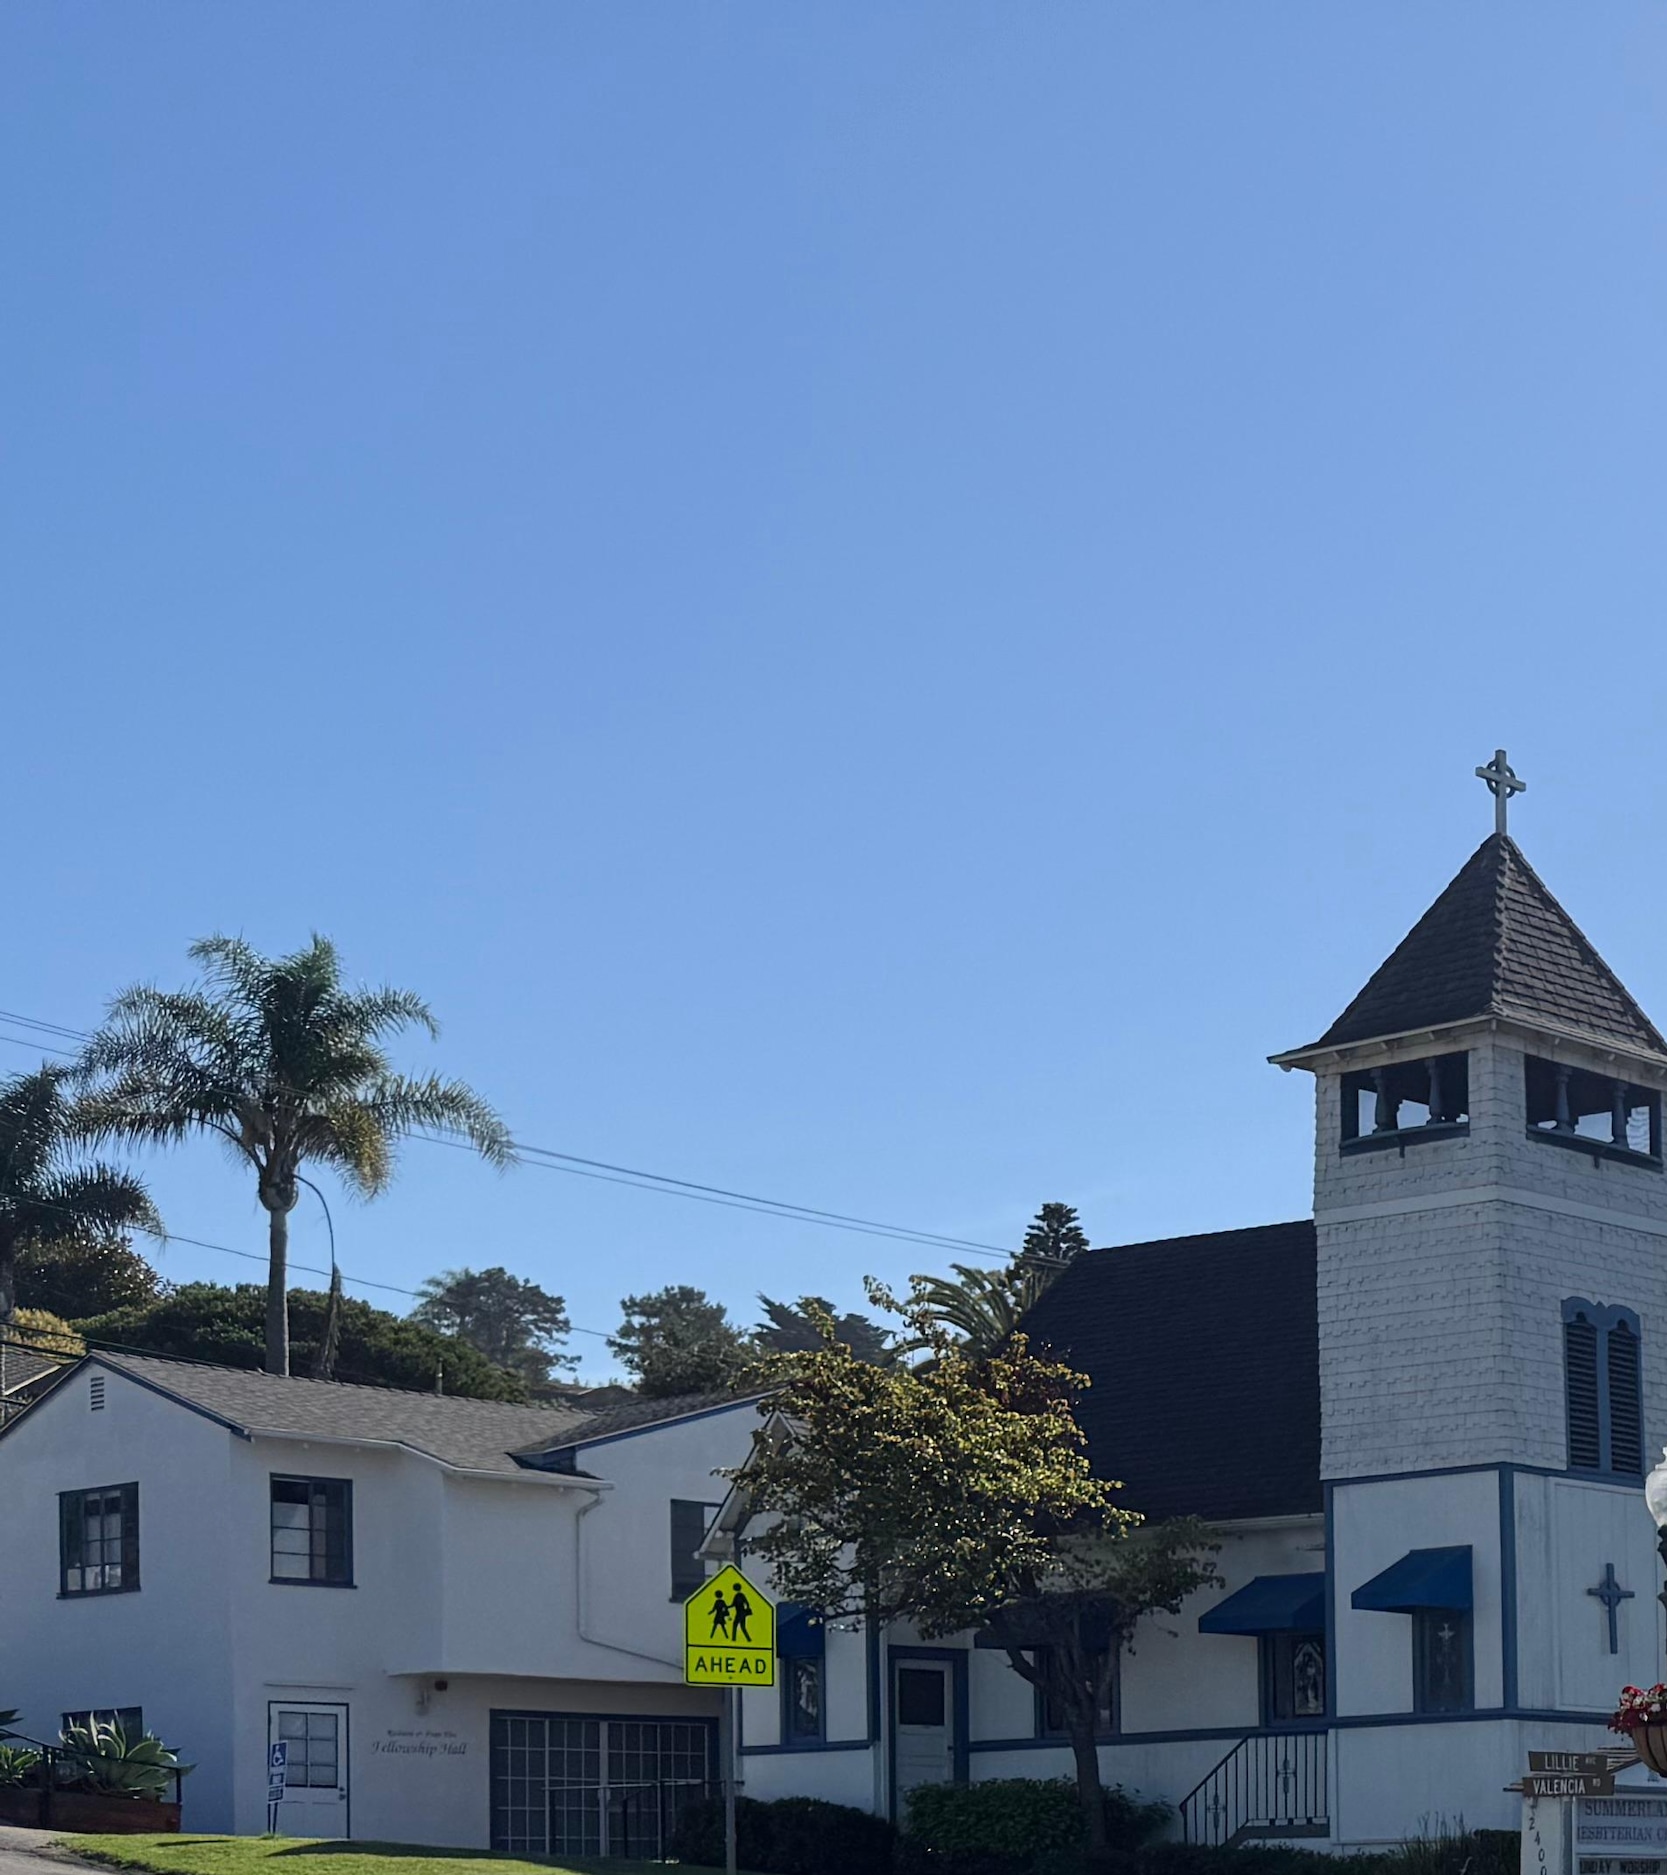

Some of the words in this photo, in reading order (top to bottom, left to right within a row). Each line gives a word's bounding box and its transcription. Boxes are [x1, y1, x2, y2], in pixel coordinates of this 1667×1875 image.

[694, 1656, 766, 1674] AHEAD
[1545, 1754, 1580, 1771] LILLIE
[1533, 1779, 1586, 1794] VALENCIA
[1578, 1826, 1652, 1841] ESBYTERIAN
[1580, 1861, 1612, 1874] UNDAY
[1620, 1860, 1661, 1874] WORSHIP
